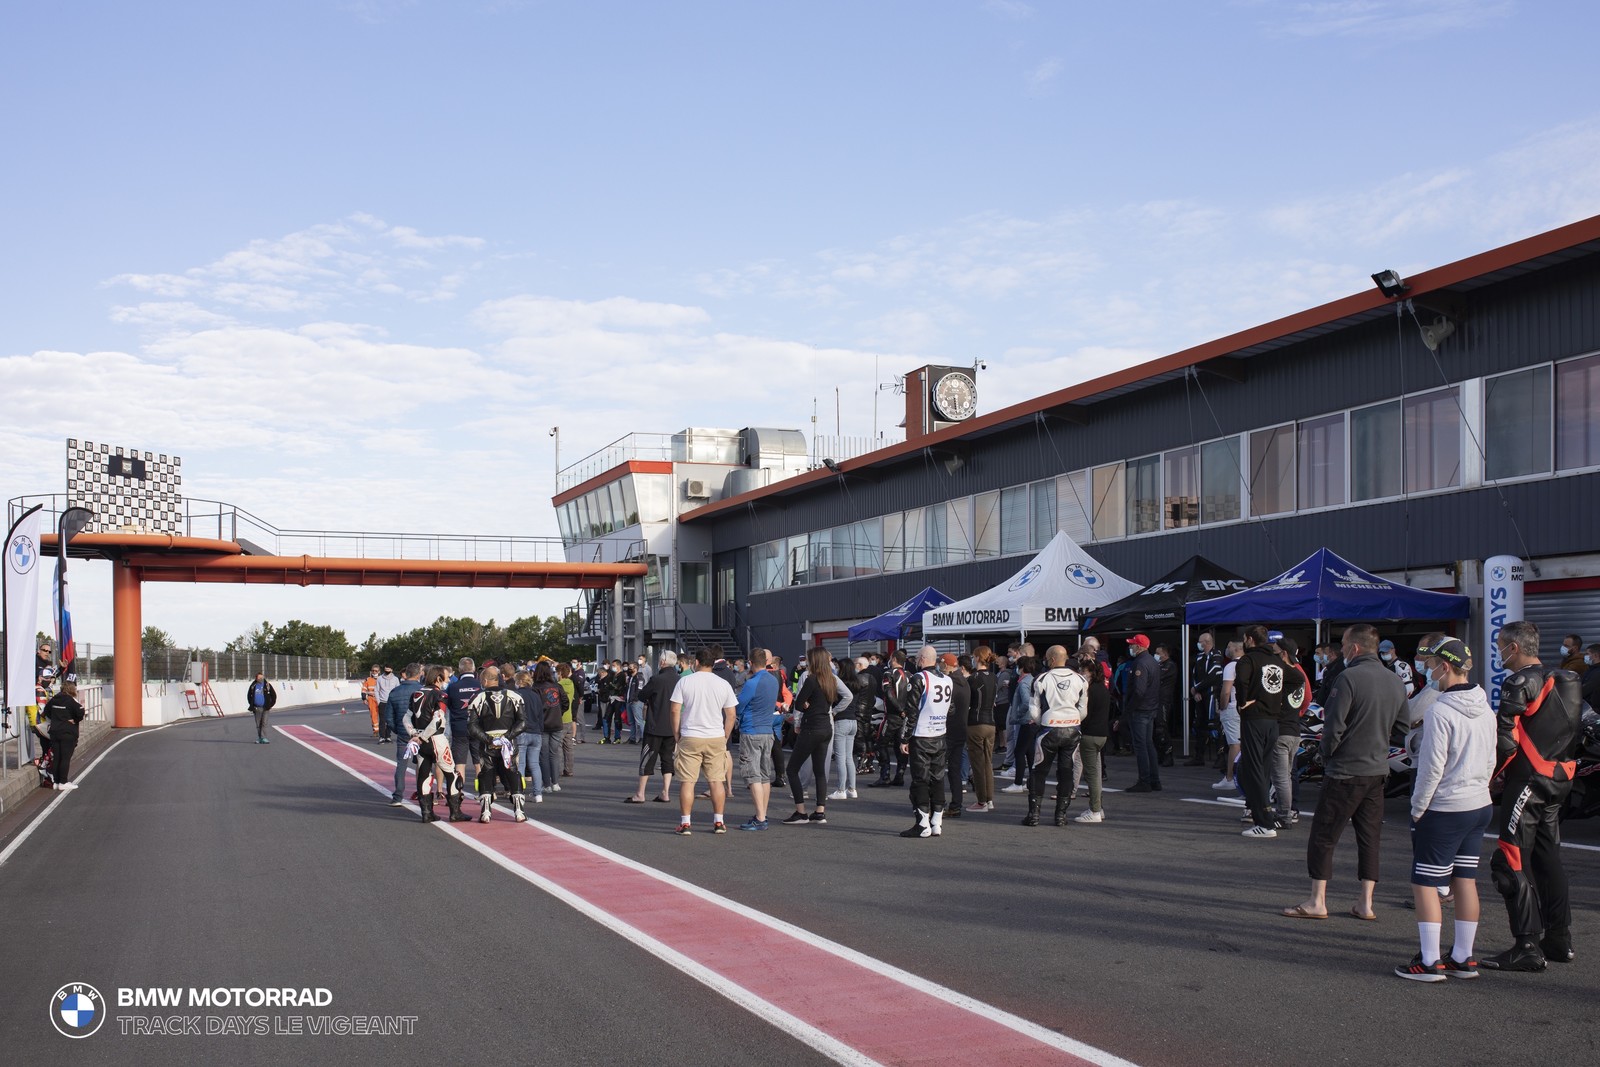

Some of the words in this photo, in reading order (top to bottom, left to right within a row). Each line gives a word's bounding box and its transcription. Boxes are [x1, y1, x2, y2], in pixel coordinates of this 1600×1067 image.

[1067, 565, 1093, 573] BMW
[1140, 580, 1188, 596] BMC
[1201, 579, 1249, 591] BMC
[932, 611, 954, 626] BMW
[956, 609, 1010, 625] MOTORRAD
[1045, 607, 1089, 622] BMW
[932, 684, 952, 703] 39
[1507, 785, 1532, 835] DAINESE
